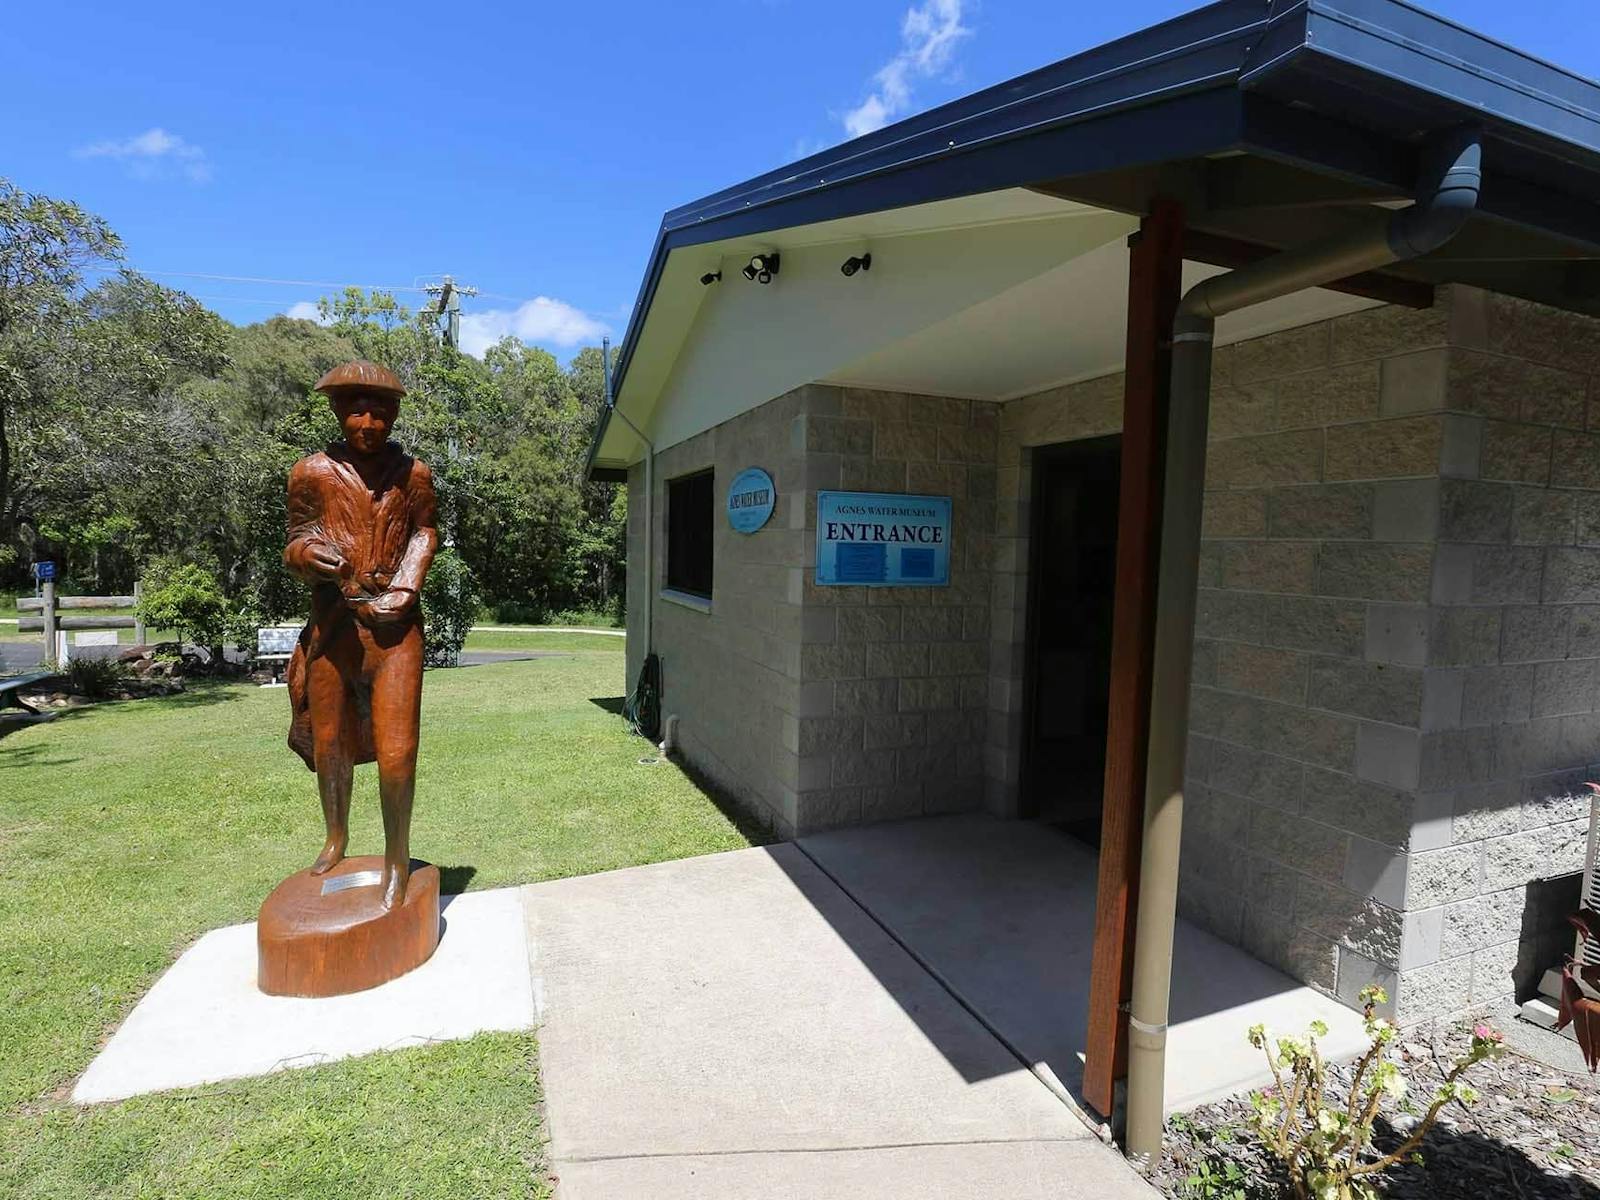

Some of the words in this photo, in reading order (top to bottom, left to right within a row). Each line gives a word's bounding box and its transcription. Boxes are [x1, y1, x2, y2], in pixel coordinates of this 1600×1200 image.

[836, 505, 866, 515] AGNES
[867, 506, 899, 516] WATER
[900, 508, 936, 518] MUSEUM
[826, 522, 943, 543] ENTRANCE
